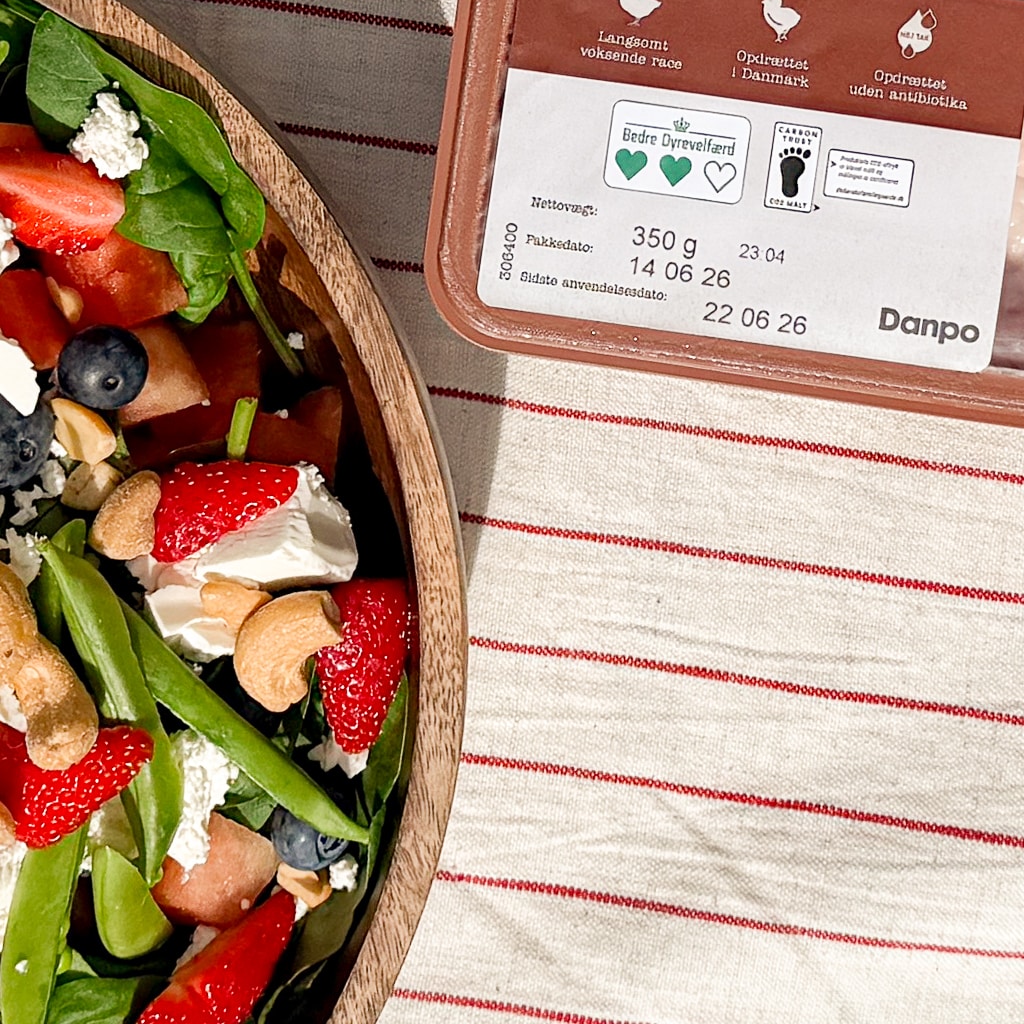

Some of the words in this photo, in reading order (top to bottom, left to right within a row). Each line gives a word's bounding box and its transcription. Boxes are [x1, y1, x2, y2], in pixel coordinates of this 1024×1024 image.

[598, 31, 669, 51] Langsomt
[580, 46, 646, 65] voksende
[651, 57, 683, 70] race
[736, 50, 809, 71] Opdrættet
[742, 68, 810, 88] Danmark
[874, 69, 947, 90] Opdrættet
[849, 84, 884, 99] uden
[889, 90, 968, 111] antibiotika
[622, 127, 657, 146] Bedre
[661, 133, 736, 156] Dyrevelfærd
[778, 126, 819, 138] CARBON
[782, 135, 812, 146] TRUST
[531, 196, 598, 217] Nettovægt:
[499, 222, 518, 281] 306400
[525, 234, 594, 253] Pakkedato:
[632, 225, 676, 251] 350
[683, 238, 697, 259] g
[630, 256, 655, 277] 14
[665, 261, 693, 282] 06
[701, 267, 731, 289] 26
[520, 271, 558, 286] Sidste
[561, 278, 668, 301] anvendelsesdato:
[703, 302, 733, 324] 22
[741, 307, 770, 329] 06
[777, 313, 808, 335] 26
[878, 307, 981, 344] Danpo
